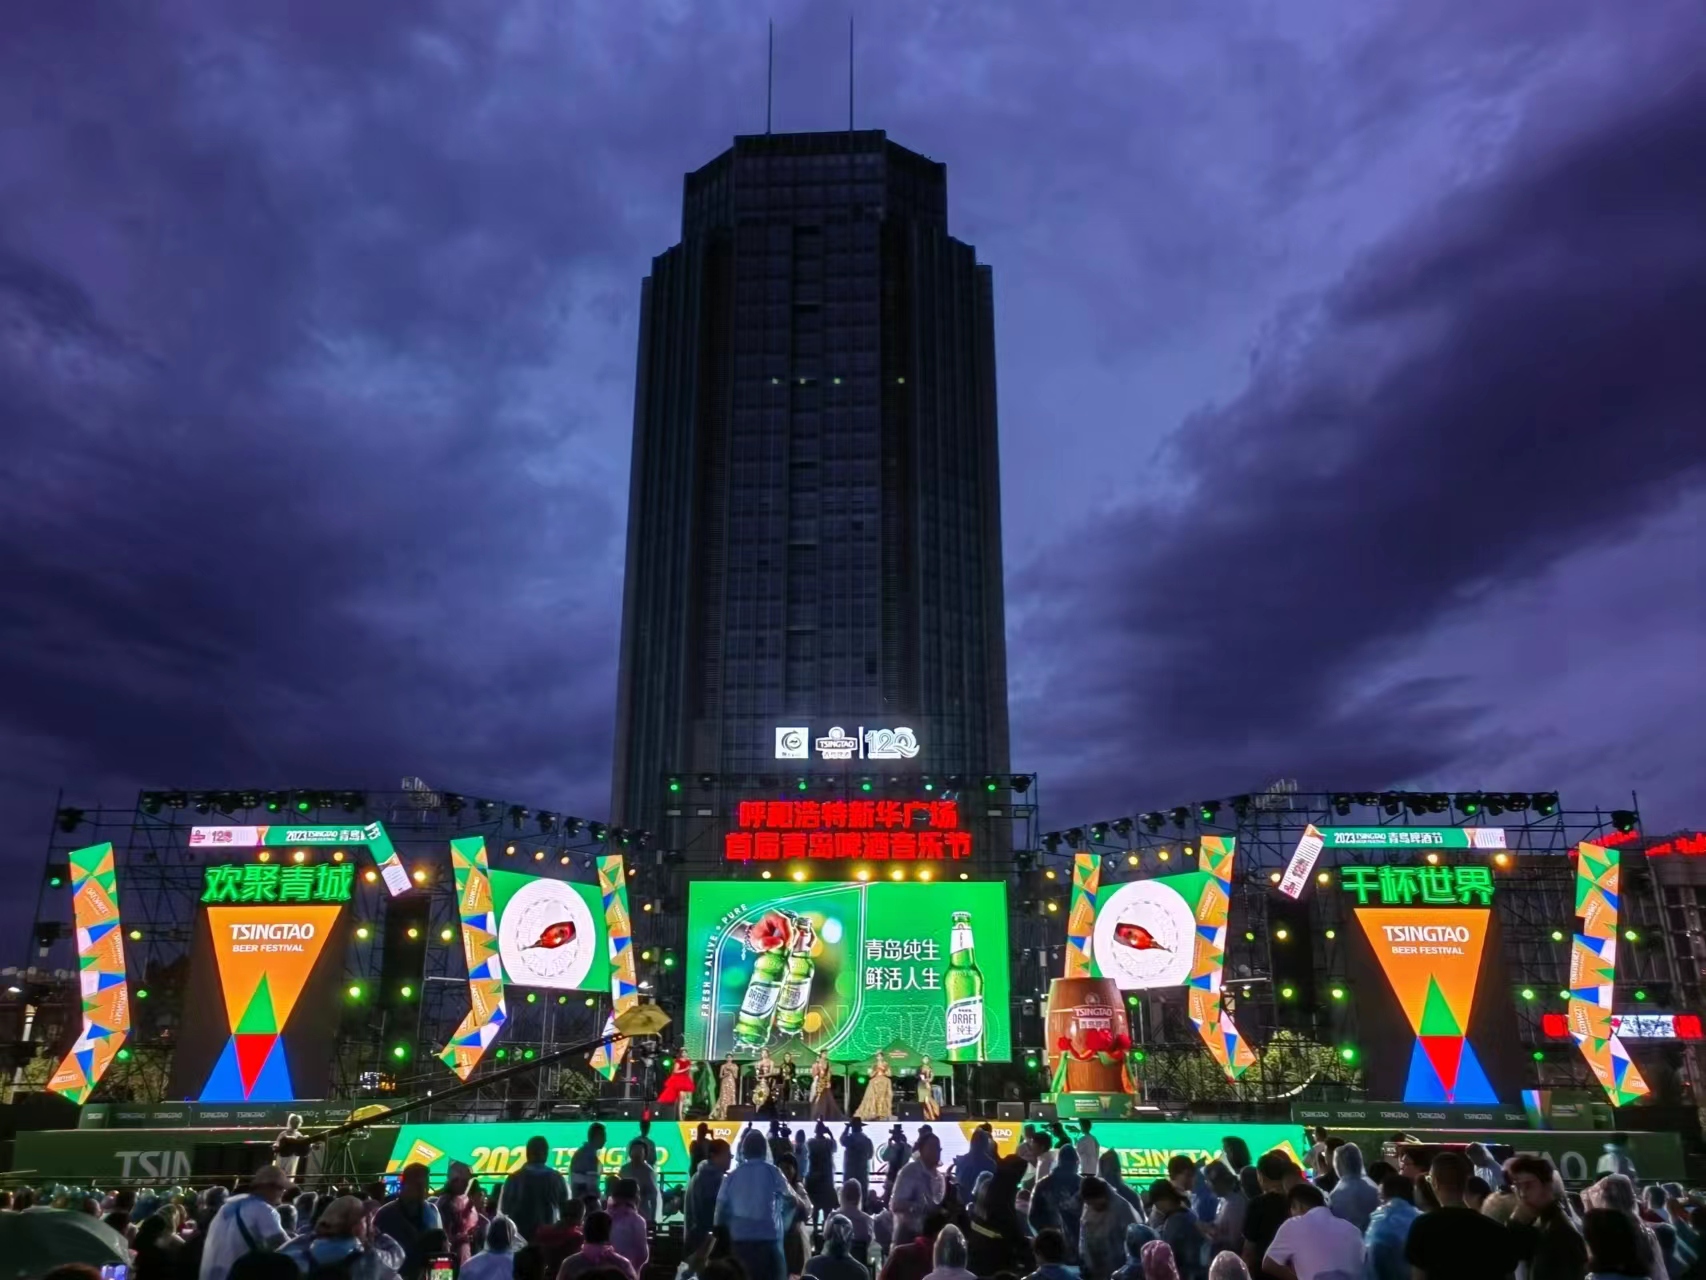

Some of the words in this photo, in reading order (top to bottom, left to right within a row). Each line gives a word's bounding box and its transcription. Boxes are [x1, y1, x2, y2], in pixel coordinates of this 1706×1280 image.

[1334, 833, 1354, 843] 2023
[202, 863, 354, 902] 欢聚青城
[1341, 865, 1495, 905] 干杯世界
[721, 903, 748, 924] PURE
[229, 923, 315, 940] TSINGTAO
[1381, 925, 1470, 942] TSINGTAO
[232, 944, 259, 952] BEER
[260, 943, 304, 952] FESTIVAL
[704, 934, 718, 967] ALIVE
[865, 939, 941, 961] 青岛纯生
[1392, 946, 1418, 954] BEER
[1420, 946, 1464, 954] FESTIVAL
[865, 966, 941, 990] 鲜活人生
[701, 981, 711, 1017] FRESH
[952, 1013, 977, 1025] DRAFT
[1075, 1008, 1112, 1017] TSINGTAO
